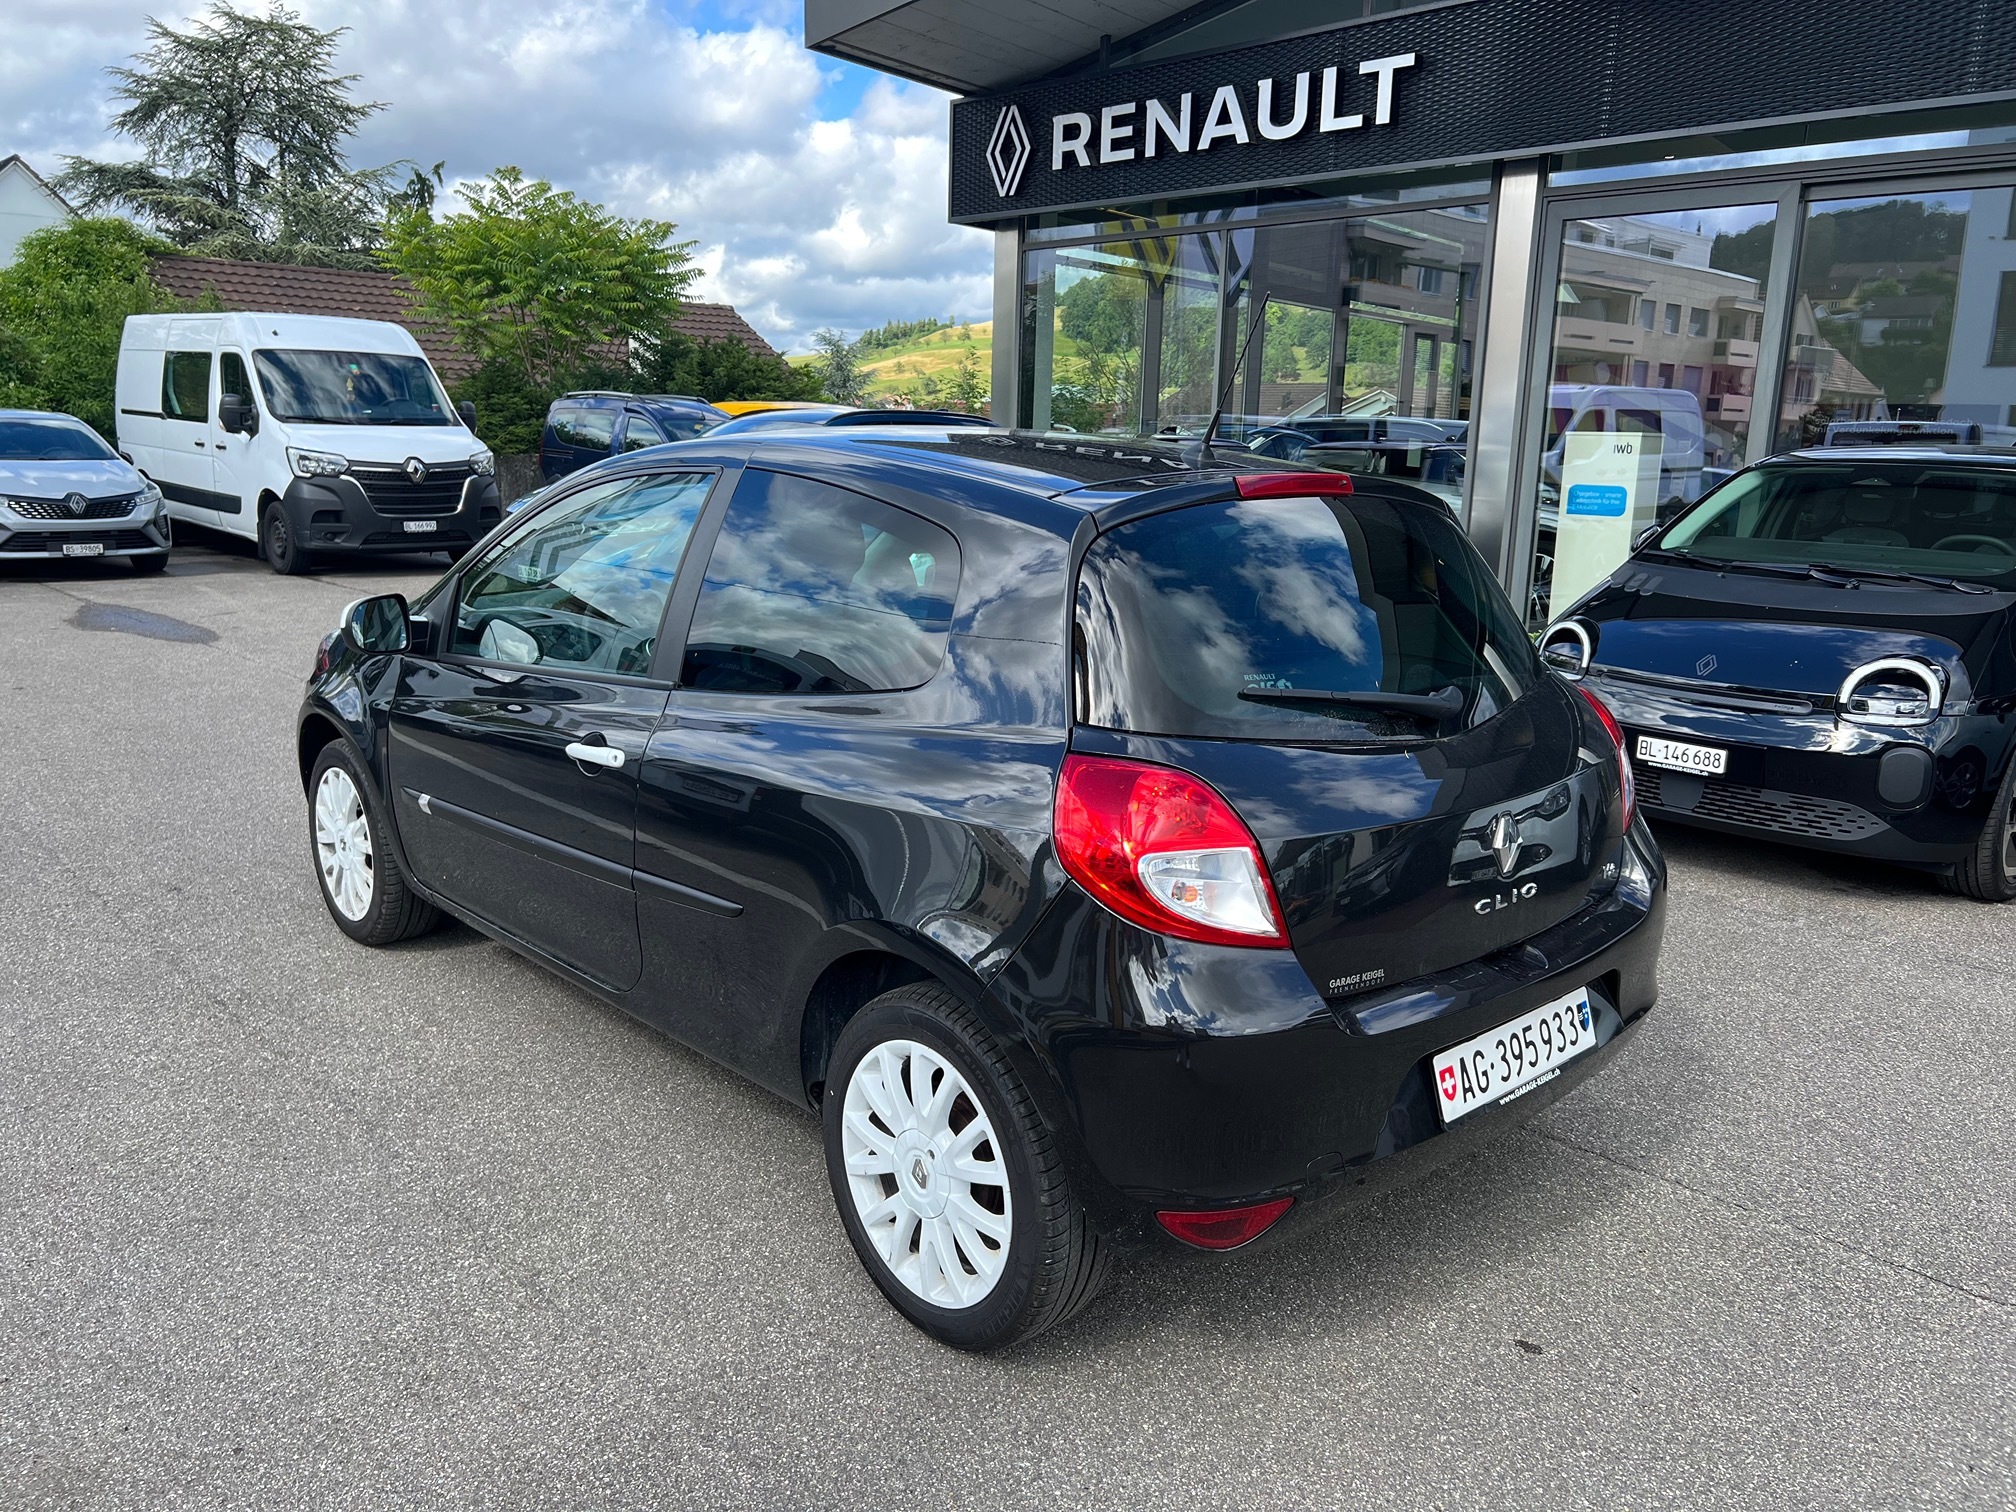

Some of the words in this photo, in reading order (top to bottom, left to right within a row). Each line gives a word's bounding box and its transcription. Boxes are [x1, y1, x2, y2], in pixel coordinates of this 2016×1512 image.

[1052, 53, 1416, 170] RENAULT
[1243, 673, 1276, 681] RENAULT
[1474, 882, 1538, 915] CLIO
[1329, 974, 1361, 988] GARAGE
[1361, 968, 1385, 981] KEIGEL
[1329, 977, 1385, 995] FRENKENDORF
[1499, 1067, 1561, 1106] www.GARAGE-KEIGEL.ch
